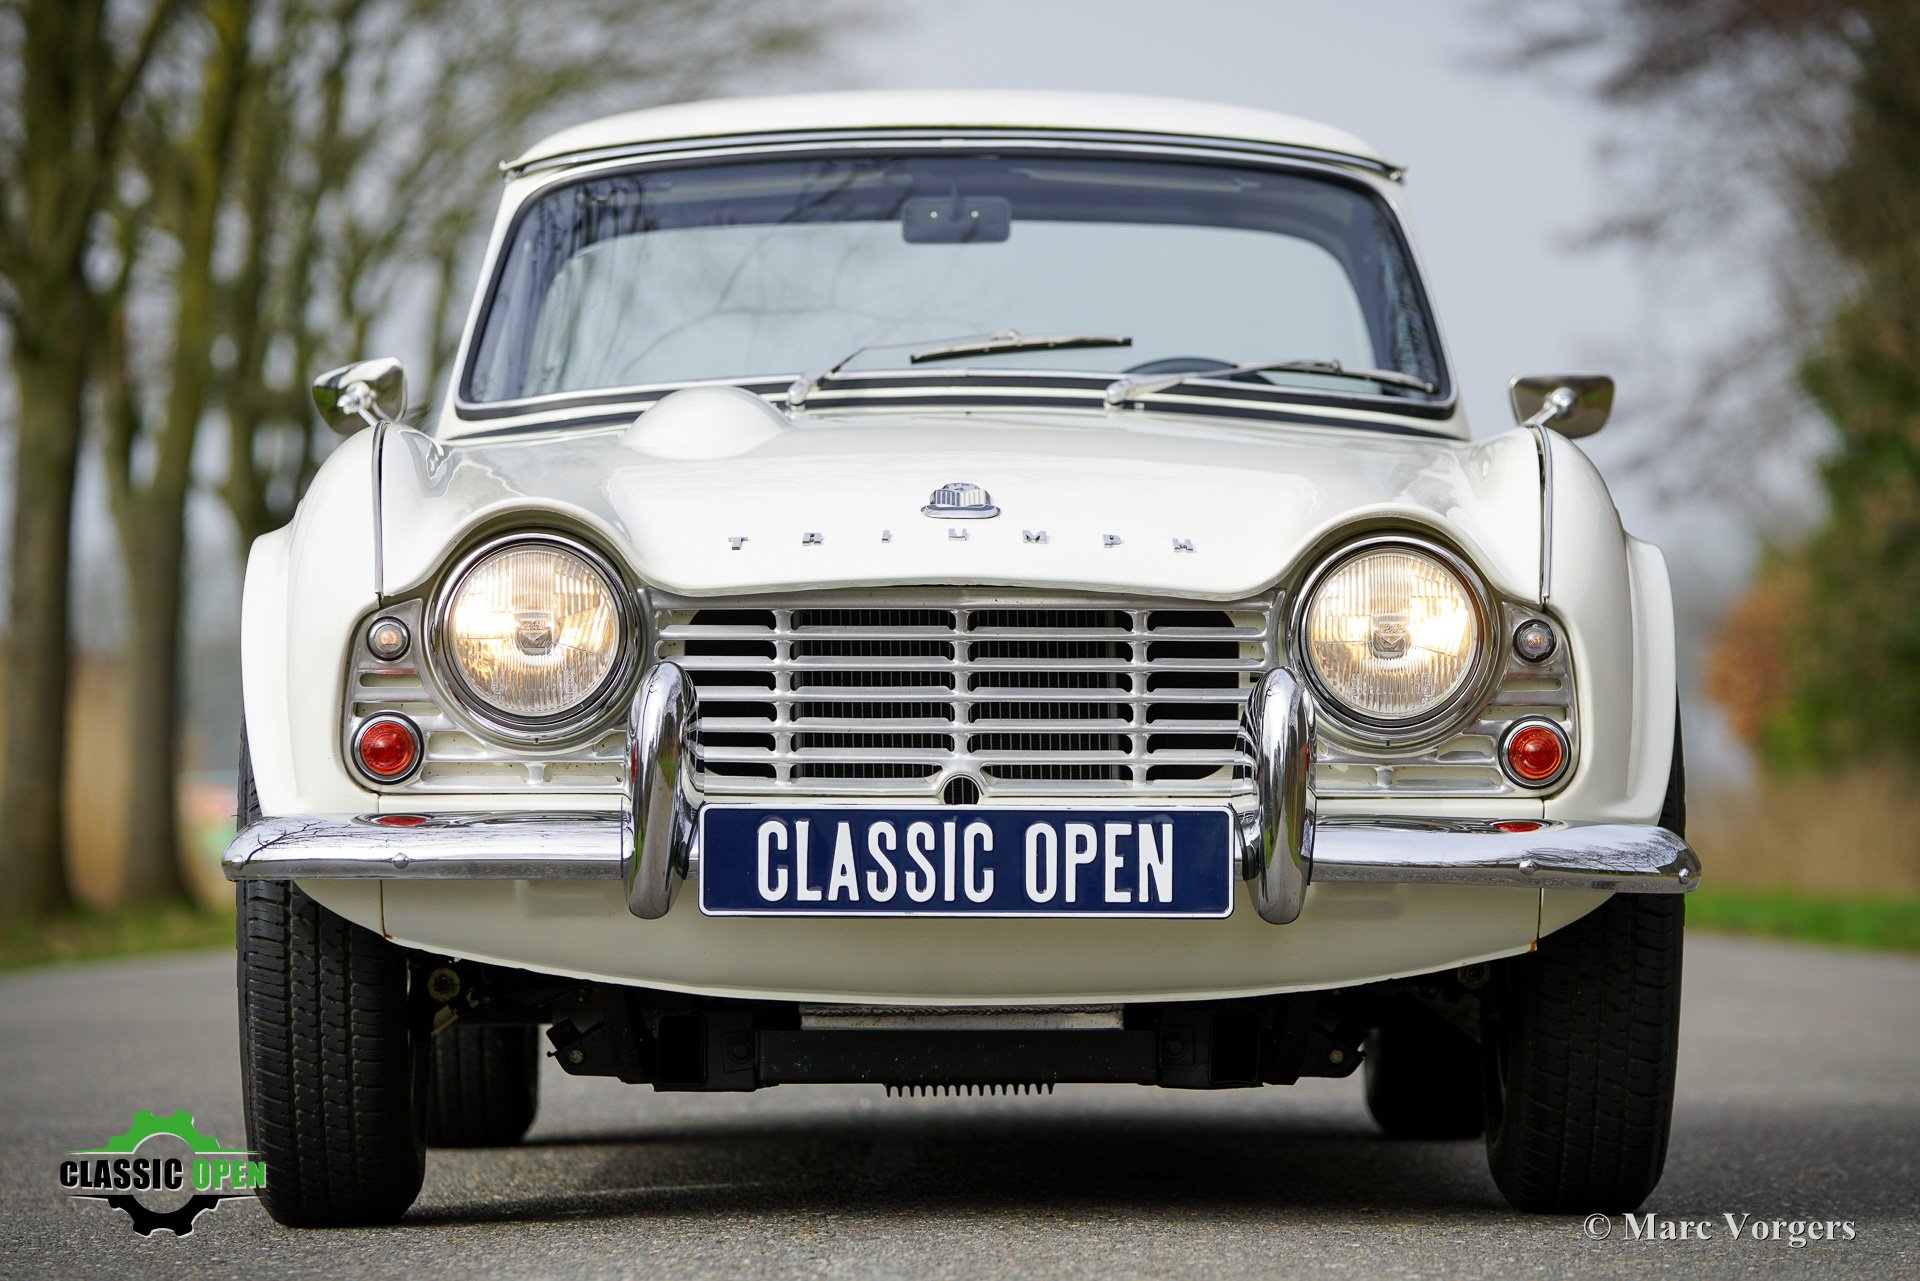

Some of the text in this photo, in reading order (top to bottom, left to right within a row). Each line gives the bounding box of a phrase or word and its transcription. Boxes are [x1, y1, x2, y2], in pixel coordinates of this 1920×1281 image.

[728, 528, 1194, 552] TRIUMPH
[757, 820, 1174, 904] CLASSIC OPEN
